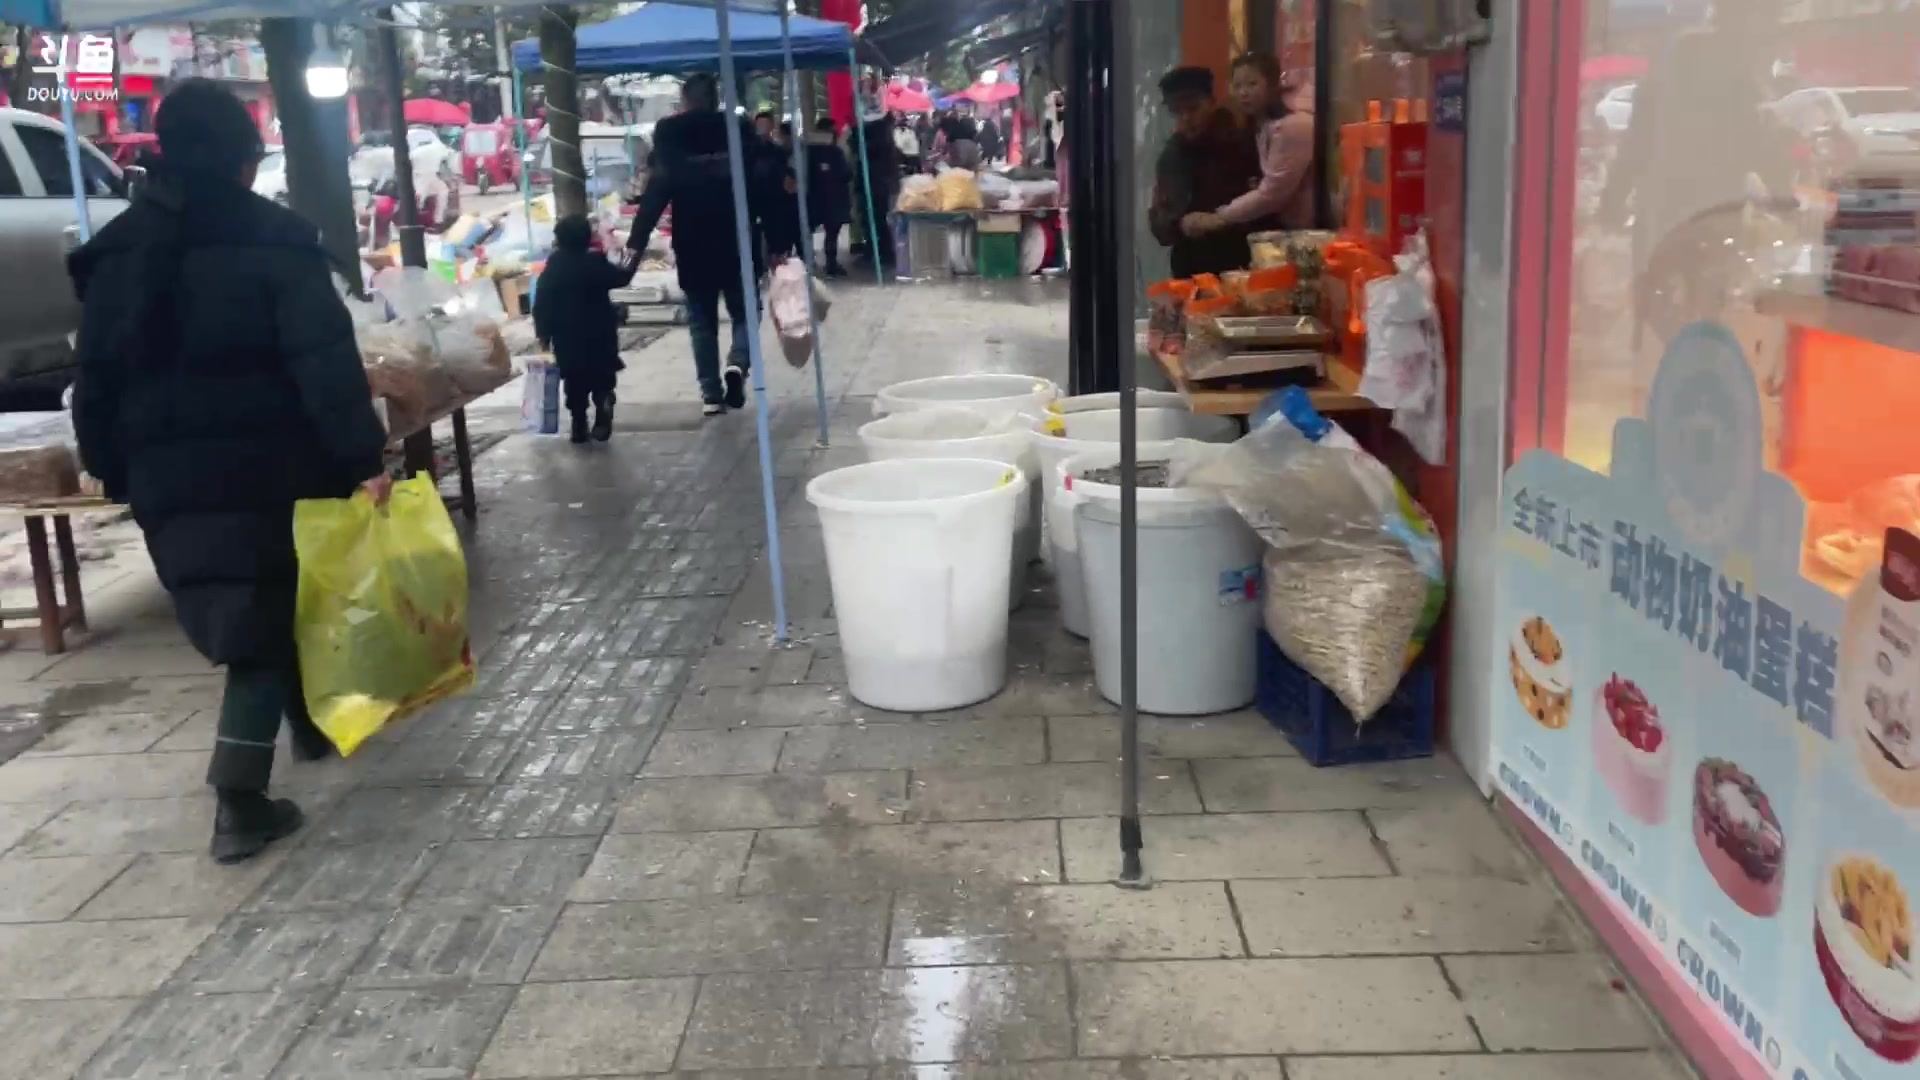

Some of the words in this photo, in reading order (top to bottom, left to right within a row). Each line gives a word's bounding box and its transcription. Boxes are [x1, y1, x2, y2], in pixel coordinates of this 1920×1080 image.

[1512, 487, 1602, 570] 全新上市
[1609, 519, 1839, 740] 动物奶油蛋糕
[1499, 762, 1561, 834] CROWN
[1581, 839, 1653, 930] CROWN
[1677, 938, 1763, 1053] CROWN
